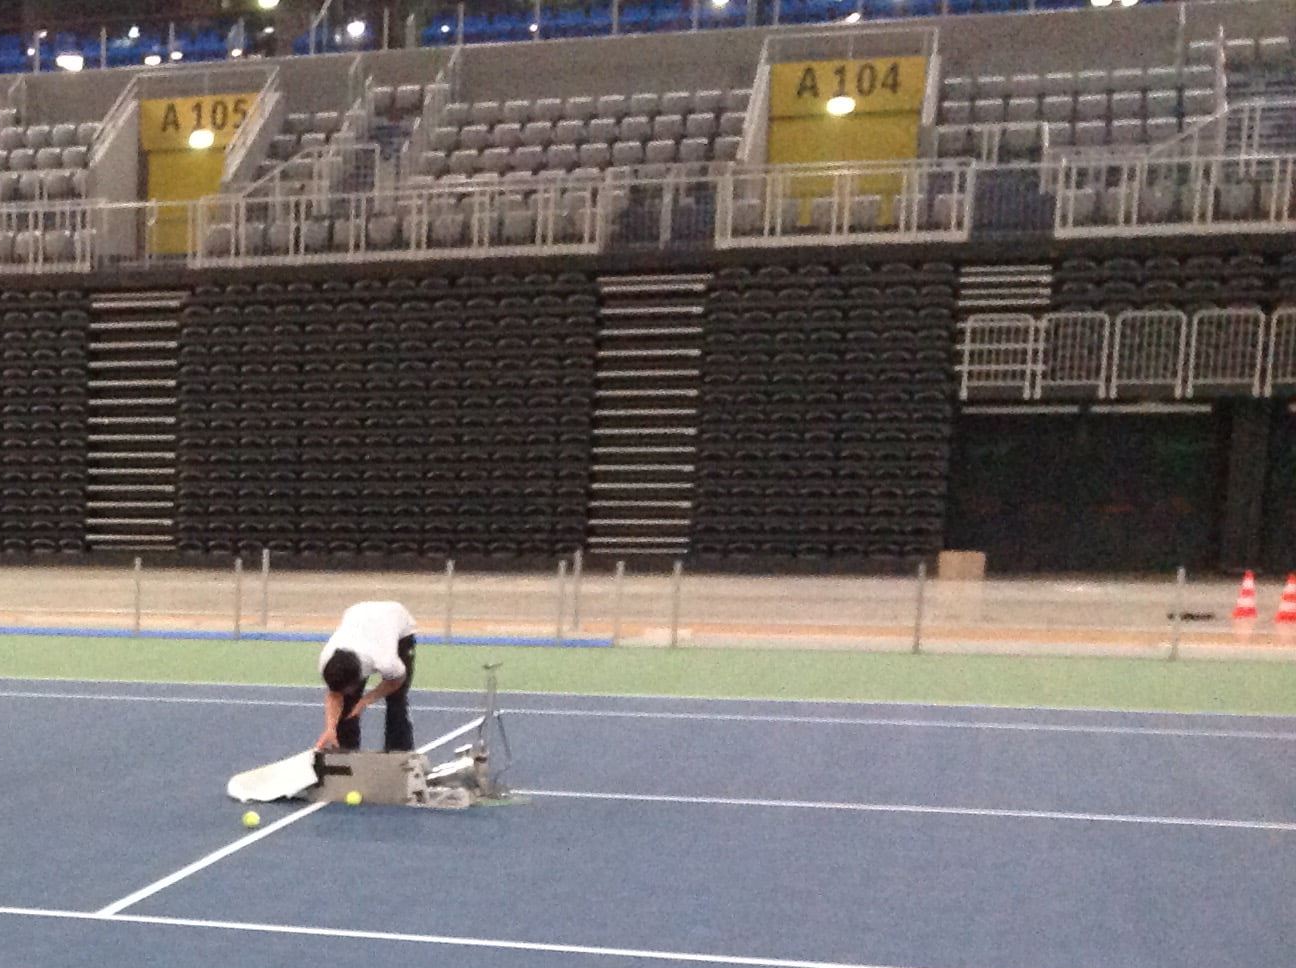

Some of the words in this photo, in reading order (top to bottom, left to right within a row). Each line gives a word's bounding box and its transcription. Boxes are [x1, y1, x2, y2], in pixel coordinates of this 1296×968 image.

[797, 66, 820, 98] A
[833, 61, 901, 97] 104
[161, 102, 180, 132] A
[192, 98, 248, 131] 105
